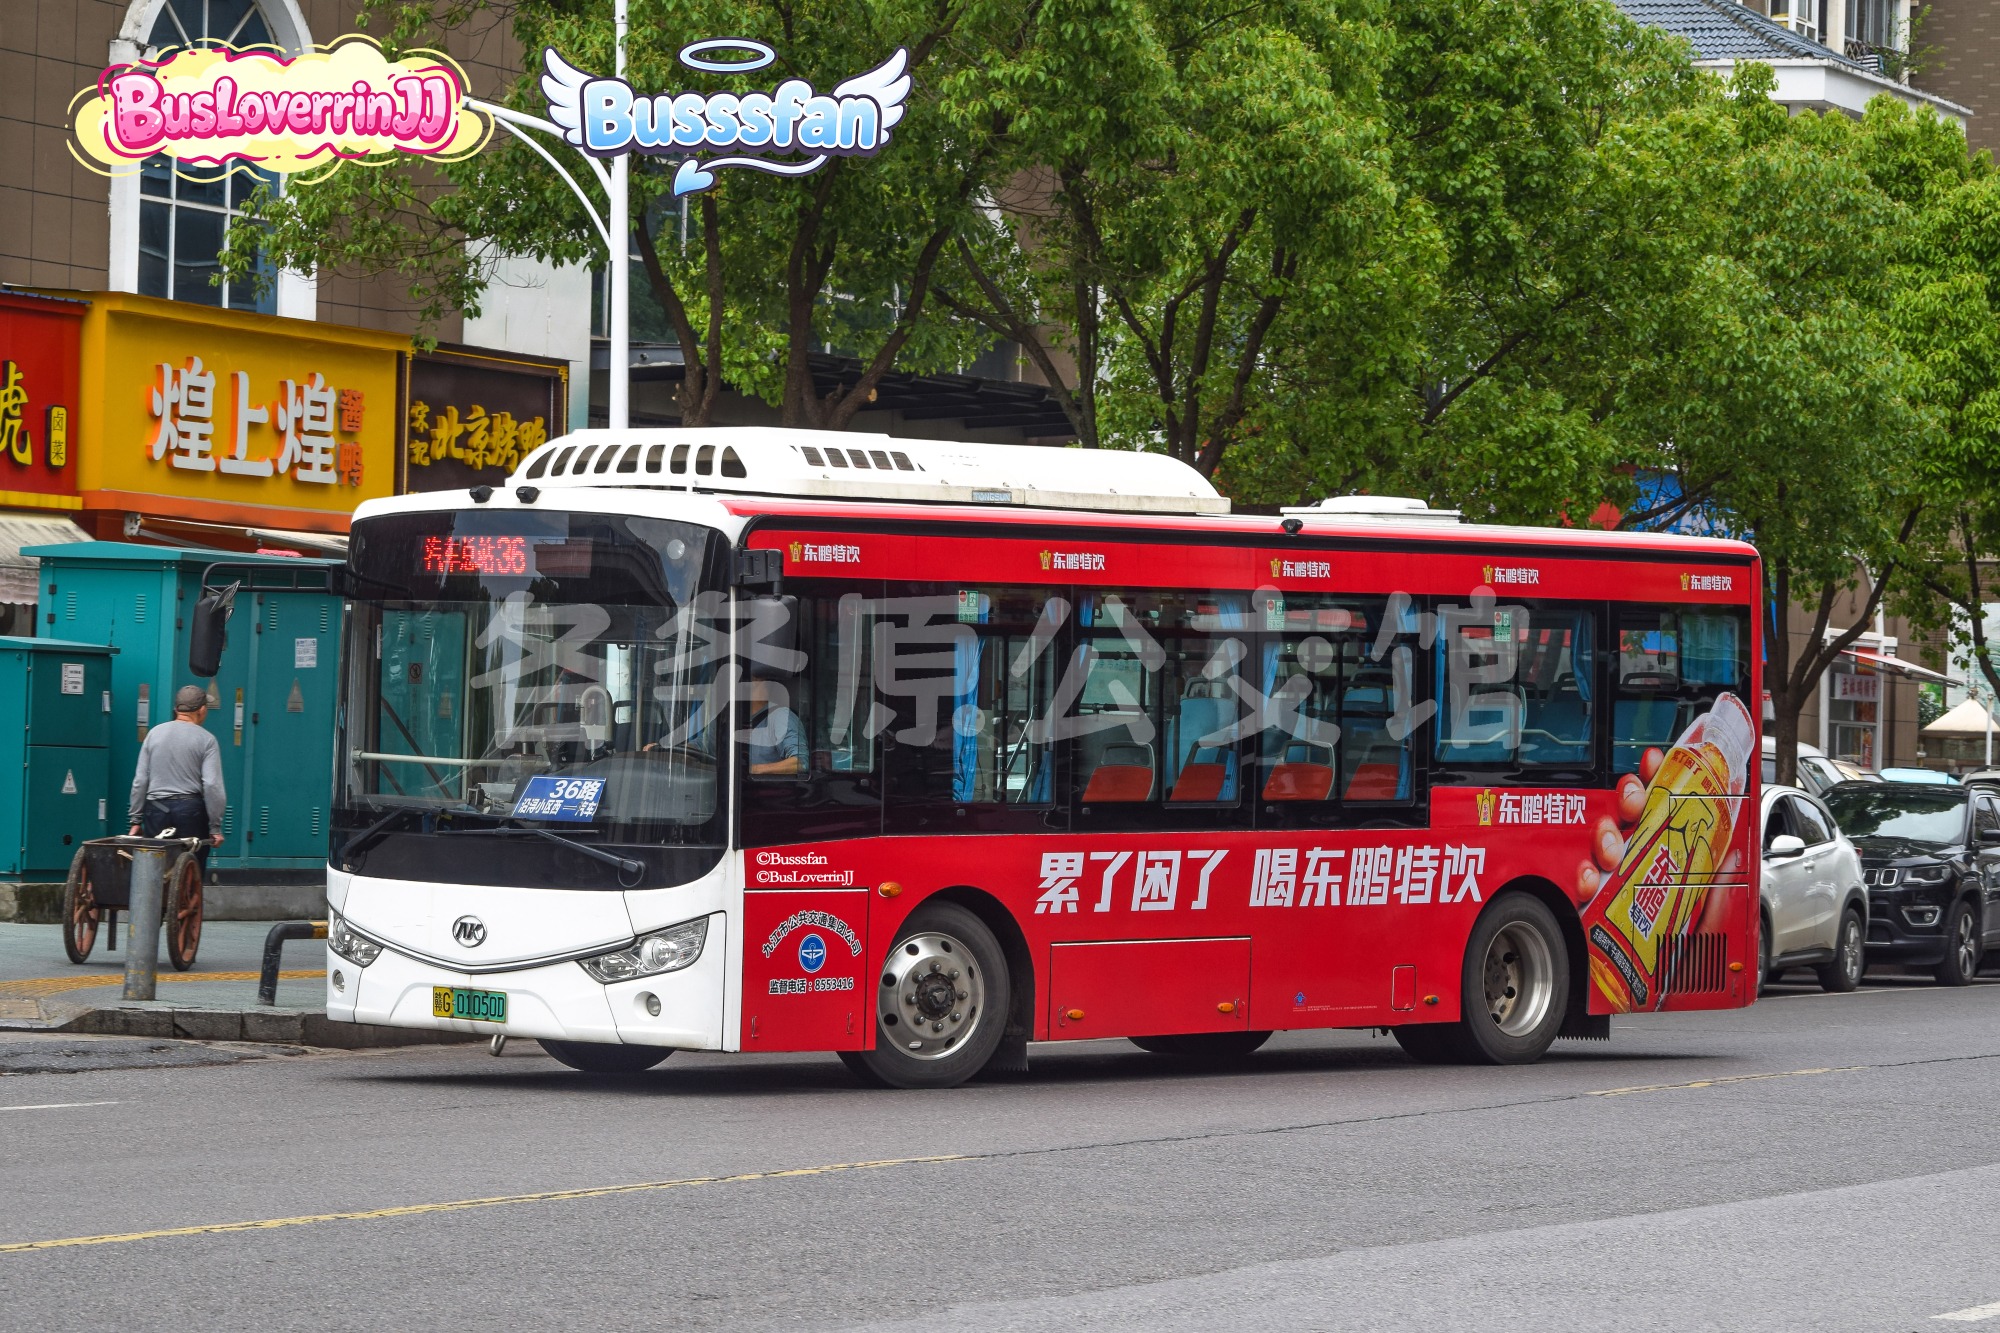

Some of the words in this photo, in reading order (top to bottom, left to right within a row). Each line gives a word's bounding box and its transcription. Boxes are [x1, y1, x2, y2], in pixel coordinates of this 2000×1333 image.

[148, 356, 337, 484] 煌上煌
[52, 411, 64, 460] 卤菜
[430, 405, 547, 474] 北京烤鸭
[804, 543, 860, 562] 东鹏特饮
[1053, 552, 1105, 570] 东鹏特饮
[1282, 560, 1330, 578] 东鹏特饮
[1494, 566, 1539, 584] 东鹏特饮
[1691, 574, 1732, 591] 东鹏特饮
[549, 780, 601, 800] 36路
[1499, 792, 1586, 824] 东鹏特饮
[1034, 850, 1229, 914] 累了困了
[1249, 843, 1486, 908] 喝东鹏特饮
[762, 910, 862, 958] 九江市公共交通集团公司
